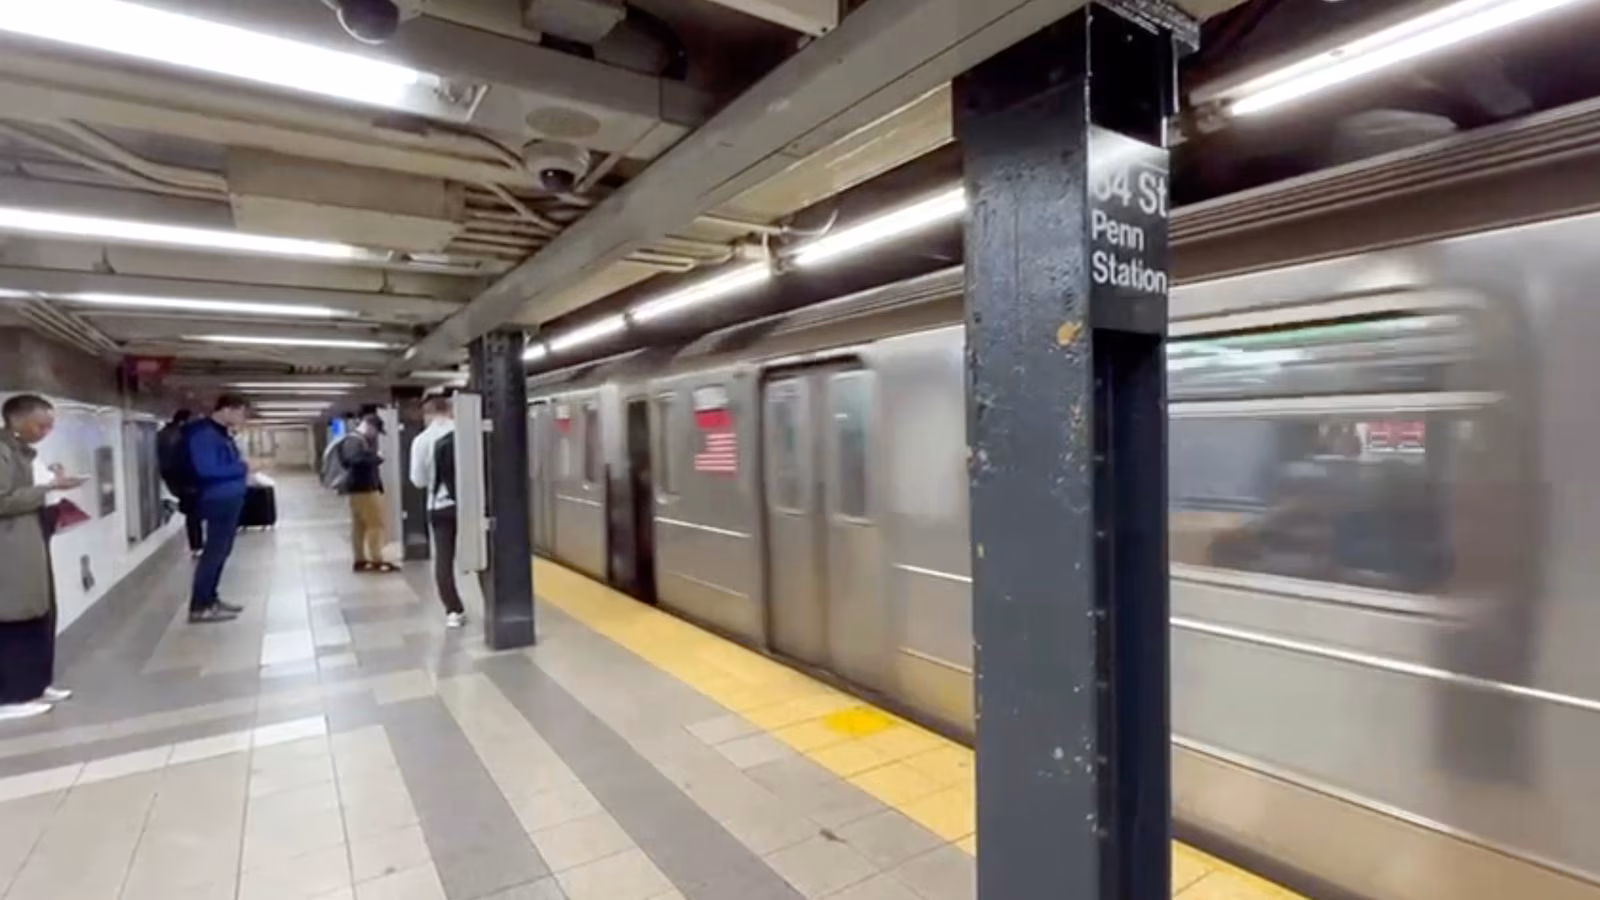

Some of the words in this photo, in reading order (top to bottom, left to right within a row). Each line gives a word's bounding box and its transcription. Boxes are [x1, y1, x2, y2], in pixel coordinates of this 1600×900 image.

[1138, 171, 1168, 218] St
[1091, 208, 1145, 251] Penn
[1092, 251, 1168, 295] Station
